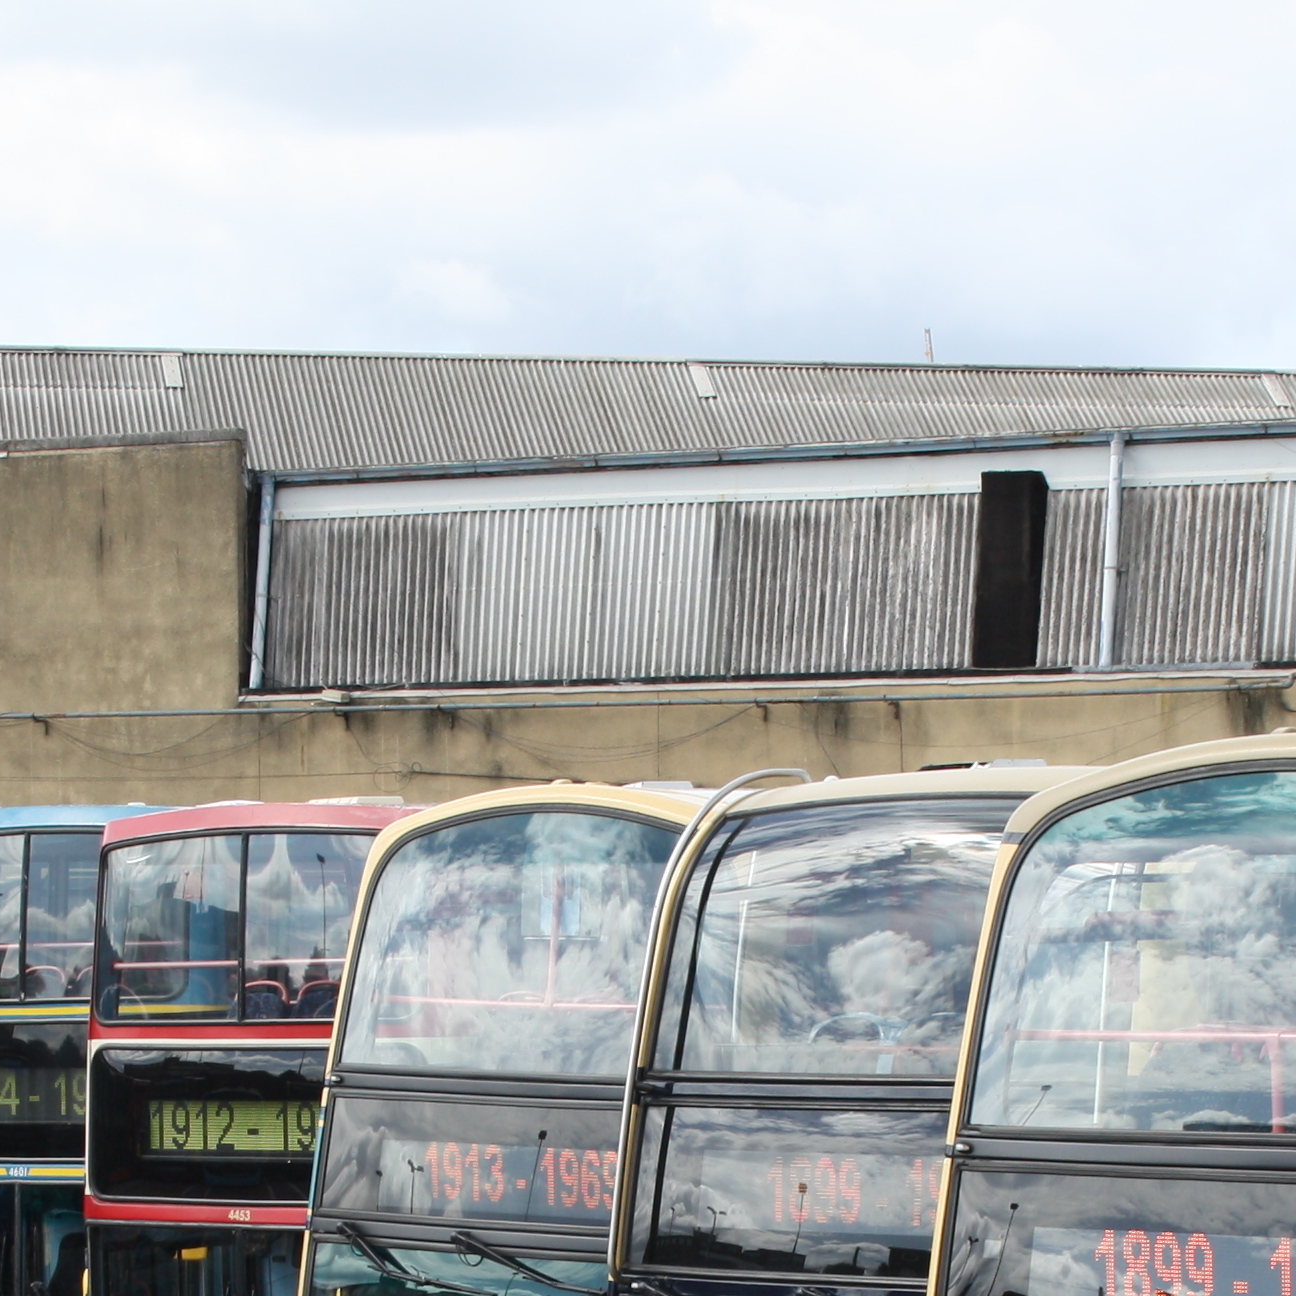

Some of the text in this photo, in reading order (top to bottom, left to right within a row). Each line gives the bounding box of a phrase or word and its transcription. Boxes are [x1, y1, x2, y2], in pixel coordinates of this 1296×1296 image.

[151, 1101, 235, 1150] 1912
[8, 1167, 28, 1177] 4601
[425, 1141, 504, 1202] 1913
[540, 1147, 618, 1209] 1969
[767, 1156, 861, 1224] 1899
[228, 1209, 251, 1221] 4453
